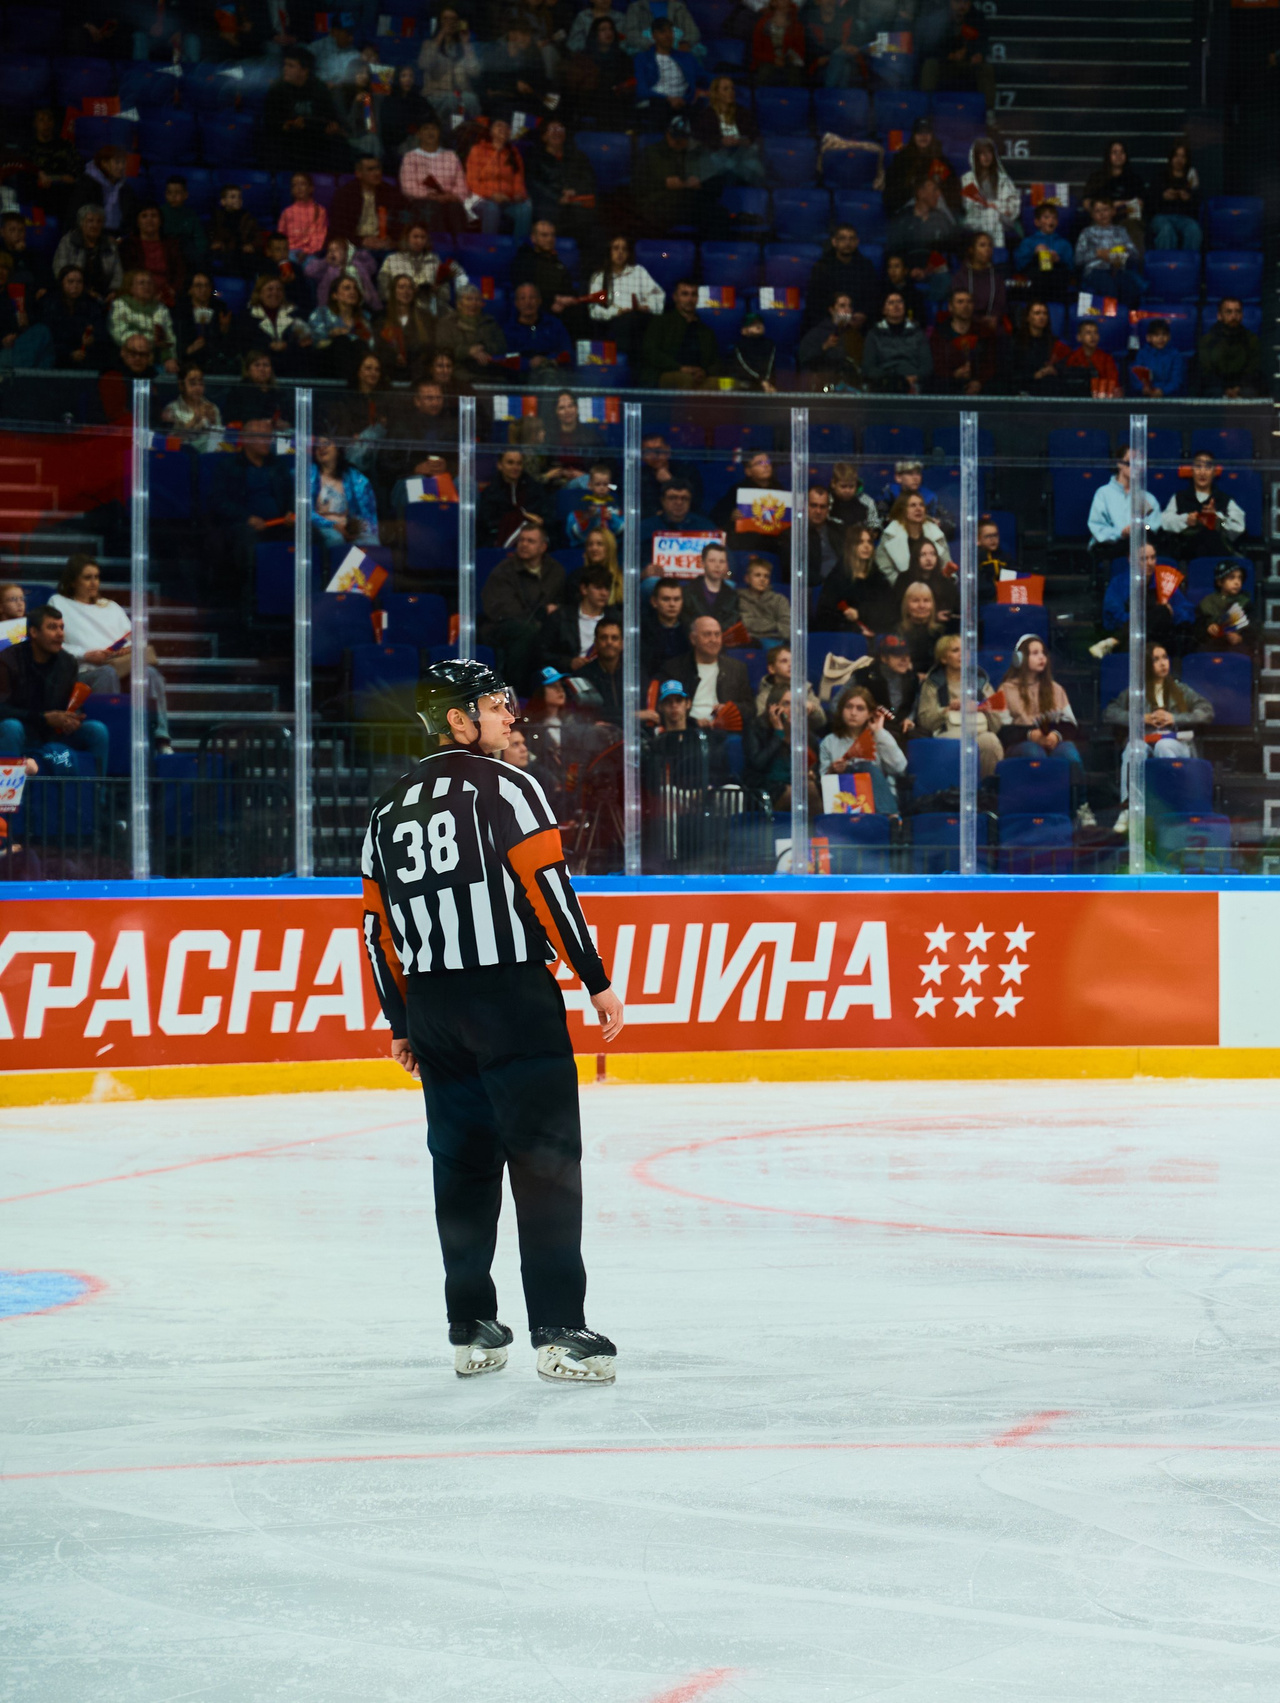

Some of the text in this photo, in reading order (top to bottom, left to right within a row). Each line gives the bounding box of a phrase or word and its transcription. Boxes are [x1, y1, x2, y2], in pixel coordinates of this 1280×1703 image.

[1004, 138, 1030, 159] 16
[392, 810, 460, 883] 38
[0, 920, 892, 1039] РАСНА ШИНА
